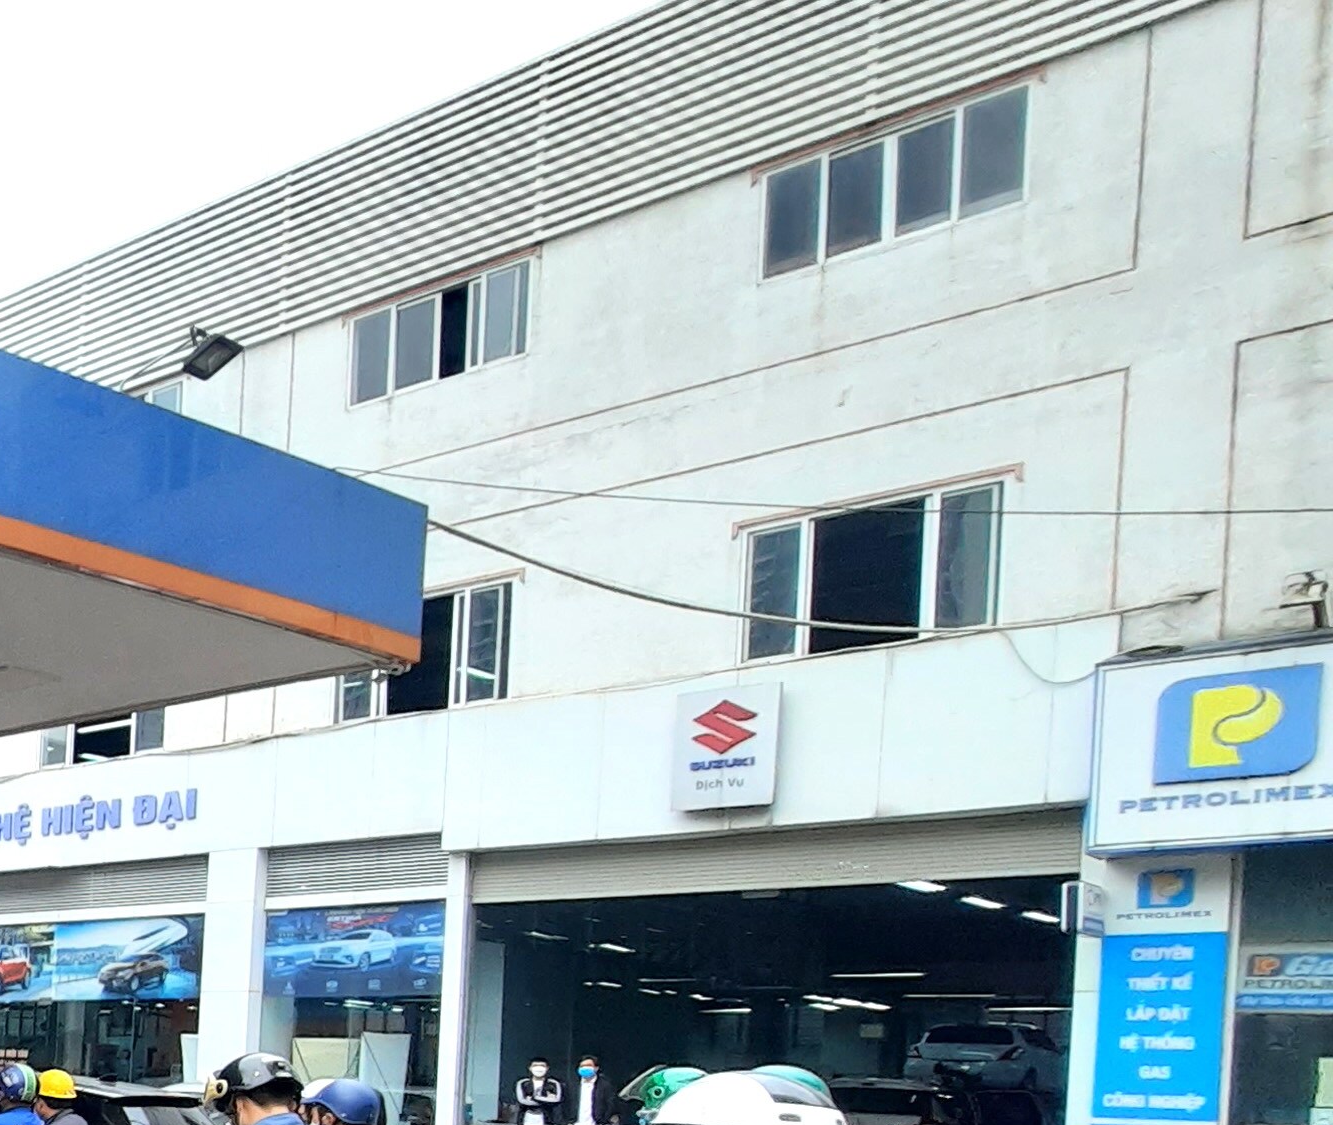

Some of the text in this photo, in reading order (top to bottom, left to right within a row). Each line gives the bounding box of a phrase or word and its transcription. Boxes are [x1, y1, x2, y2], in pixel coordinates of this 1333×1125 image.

[690, 757, 756, 771] SUZUKI
[1119, 783, 1333, 814] PETROLIMEX
[41, 795, 122, 840] HIỆN
[133, 788, 197, 830] ĐẠI
[1138, 1064, 1172, 1080] GAS
